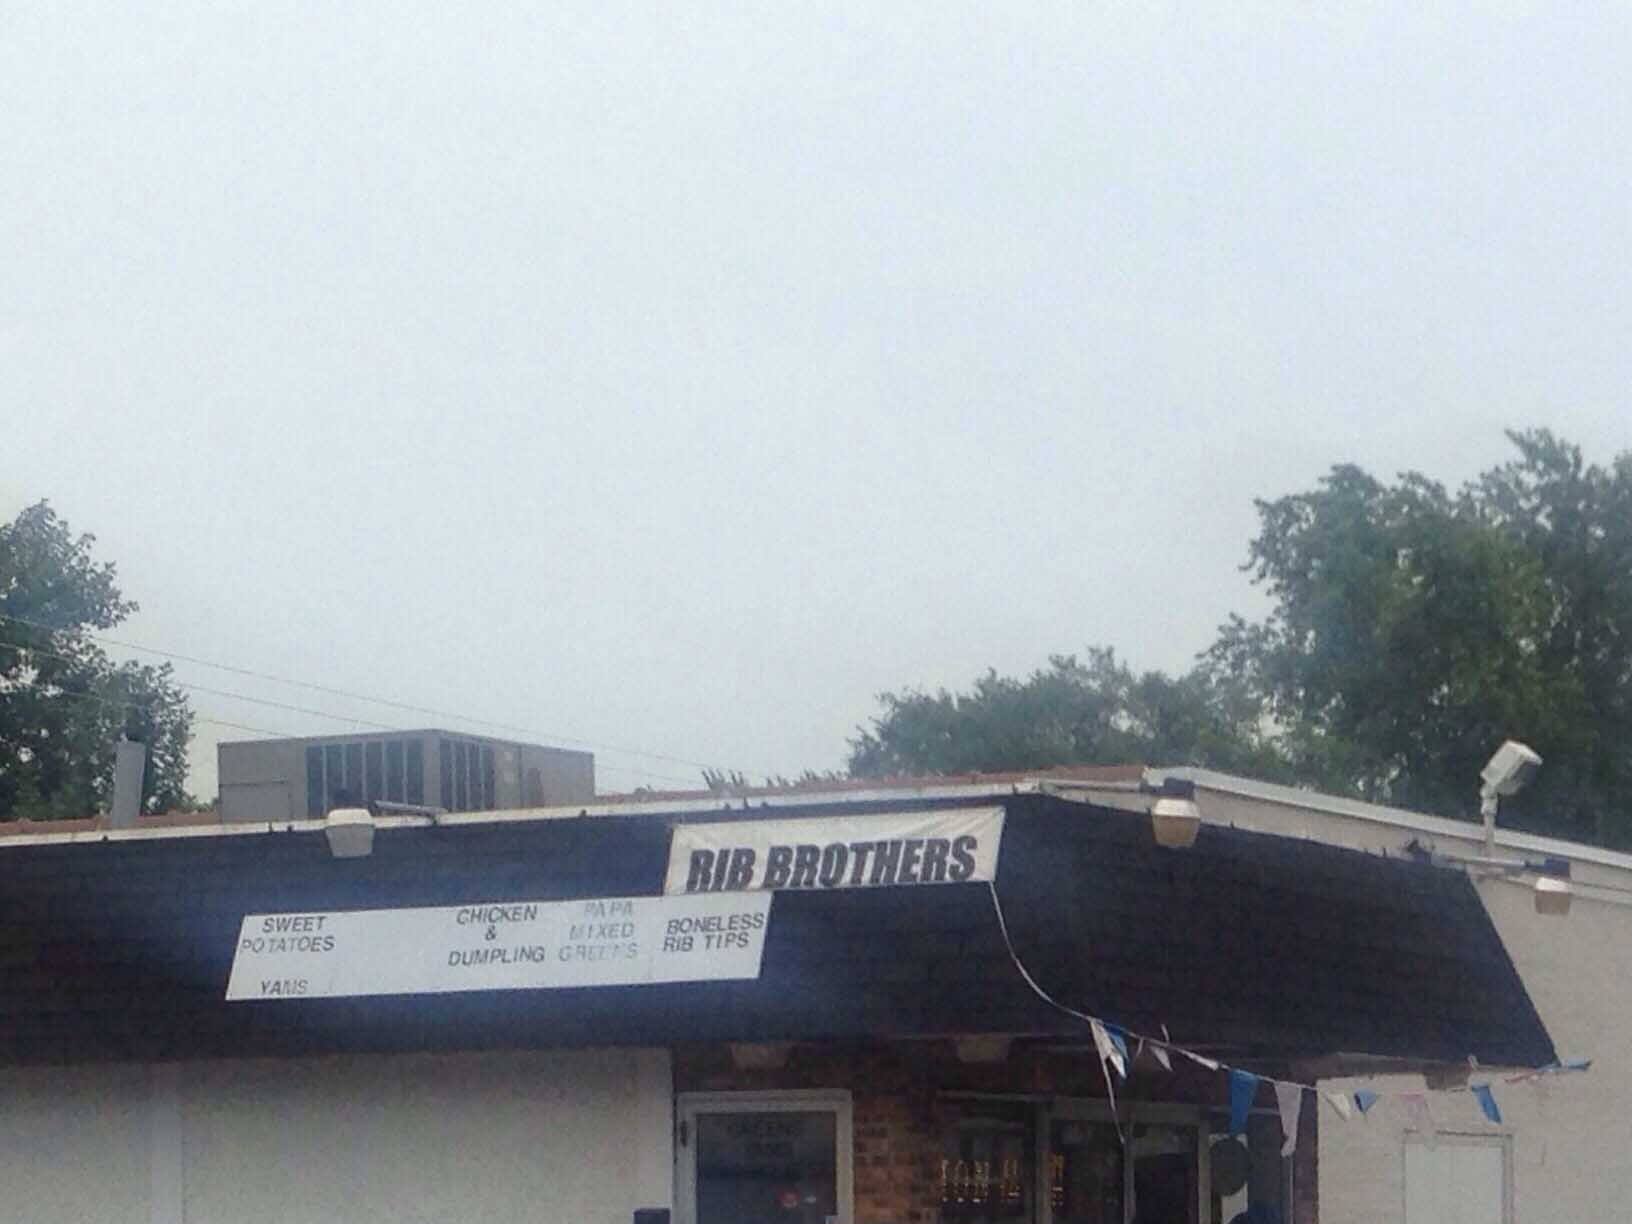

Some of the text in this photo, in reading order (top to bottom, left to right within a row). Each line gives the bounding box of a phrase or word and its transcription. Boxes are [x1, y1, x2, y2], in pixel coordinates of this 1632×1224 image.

[685, 834, 978, 892] RIB BROTHERS
[262, 915, 327, 933] SWEET
[456, 904, 538, 925] CHICKEN
[666, 912, 766, 934] BONELESS
[484, 925, 497, 941] &
[569, 922, 635, 940] MIXED
[662, 931, 751, 952] RIB TIPS
[241, 935, 336, 953] POTATOES
[447, 946, 545, 967] DUMPLING
